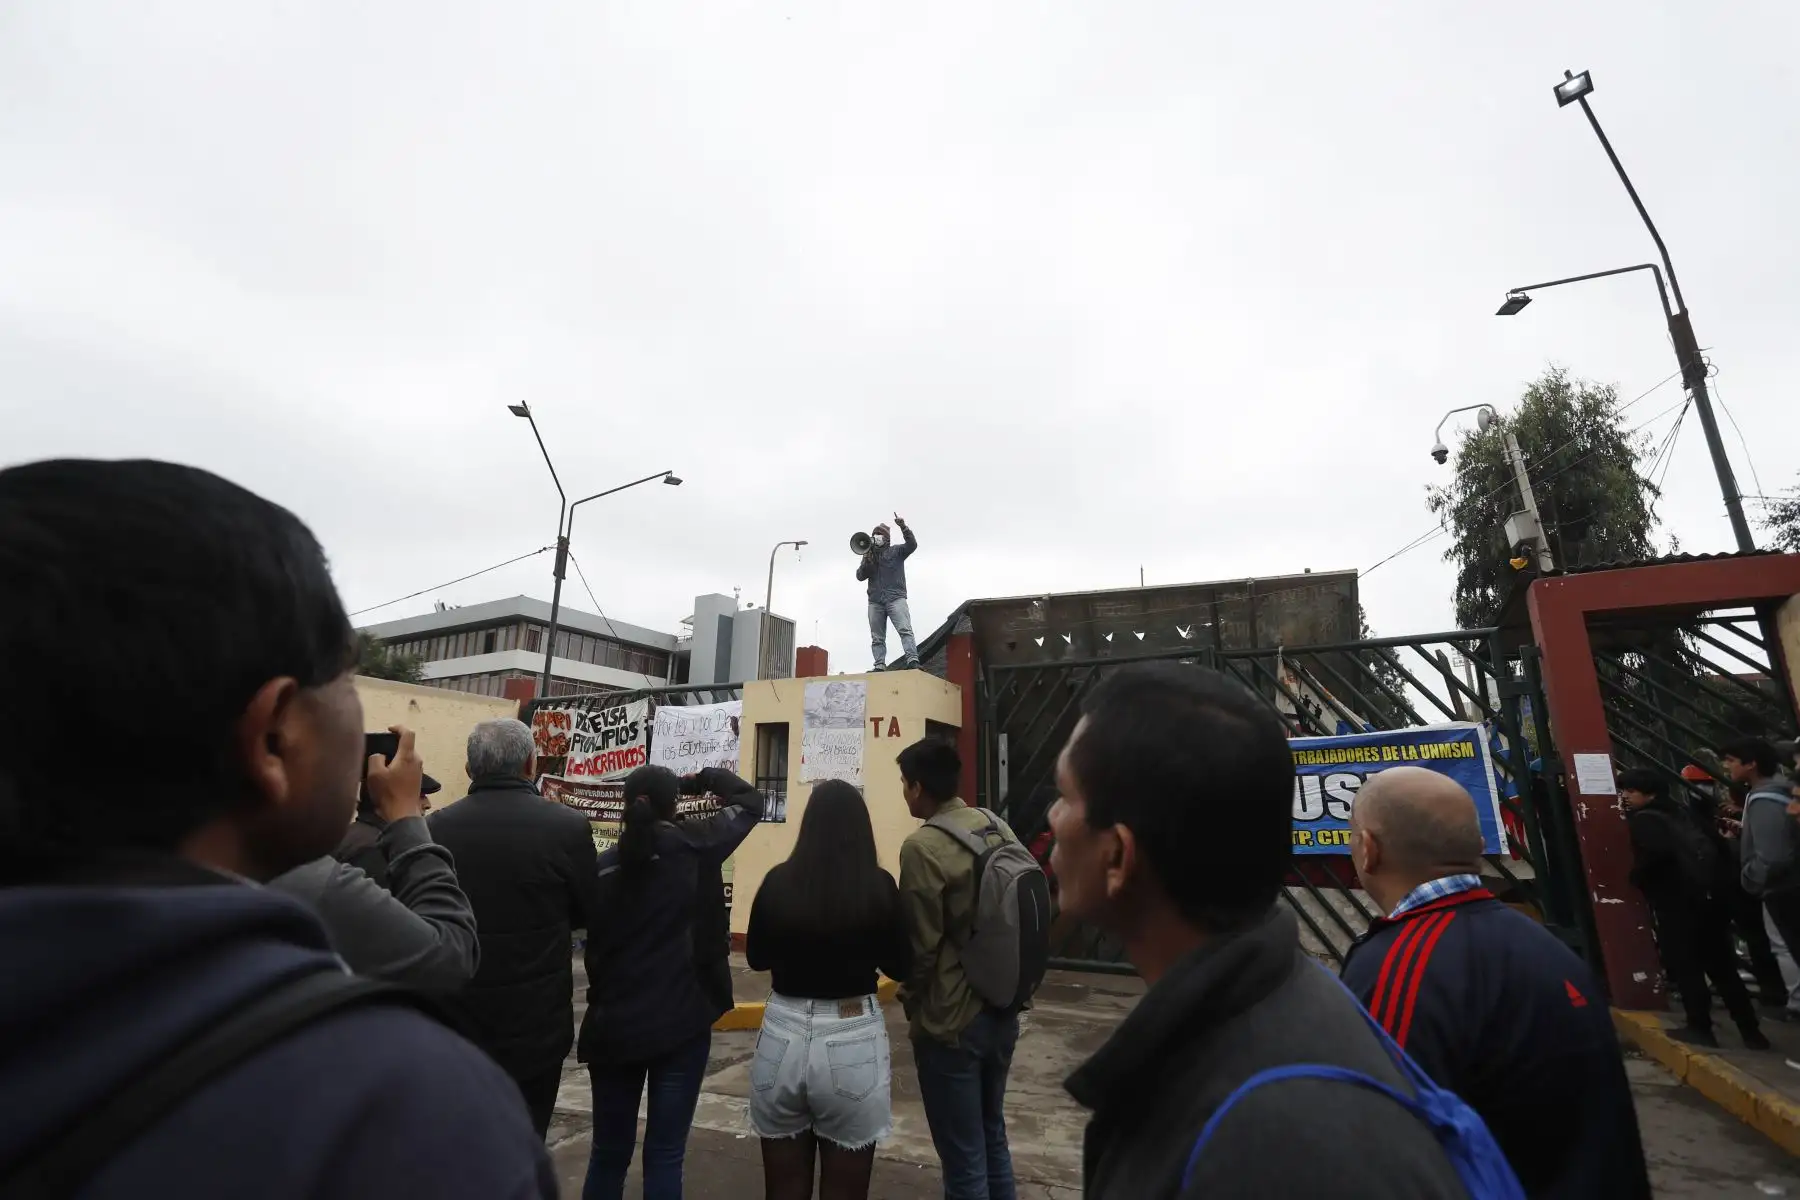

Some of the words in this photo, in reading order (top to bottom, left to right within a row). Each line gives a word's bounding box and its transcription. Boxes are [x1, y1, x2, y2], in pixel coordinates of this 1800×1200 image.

[1382, 745, 1400, 761] DE
[1401, 745, 1419, 761] LA
[1420, 742, 1475, 760] UNMSM
[1291, 773, 1374, 820] US
